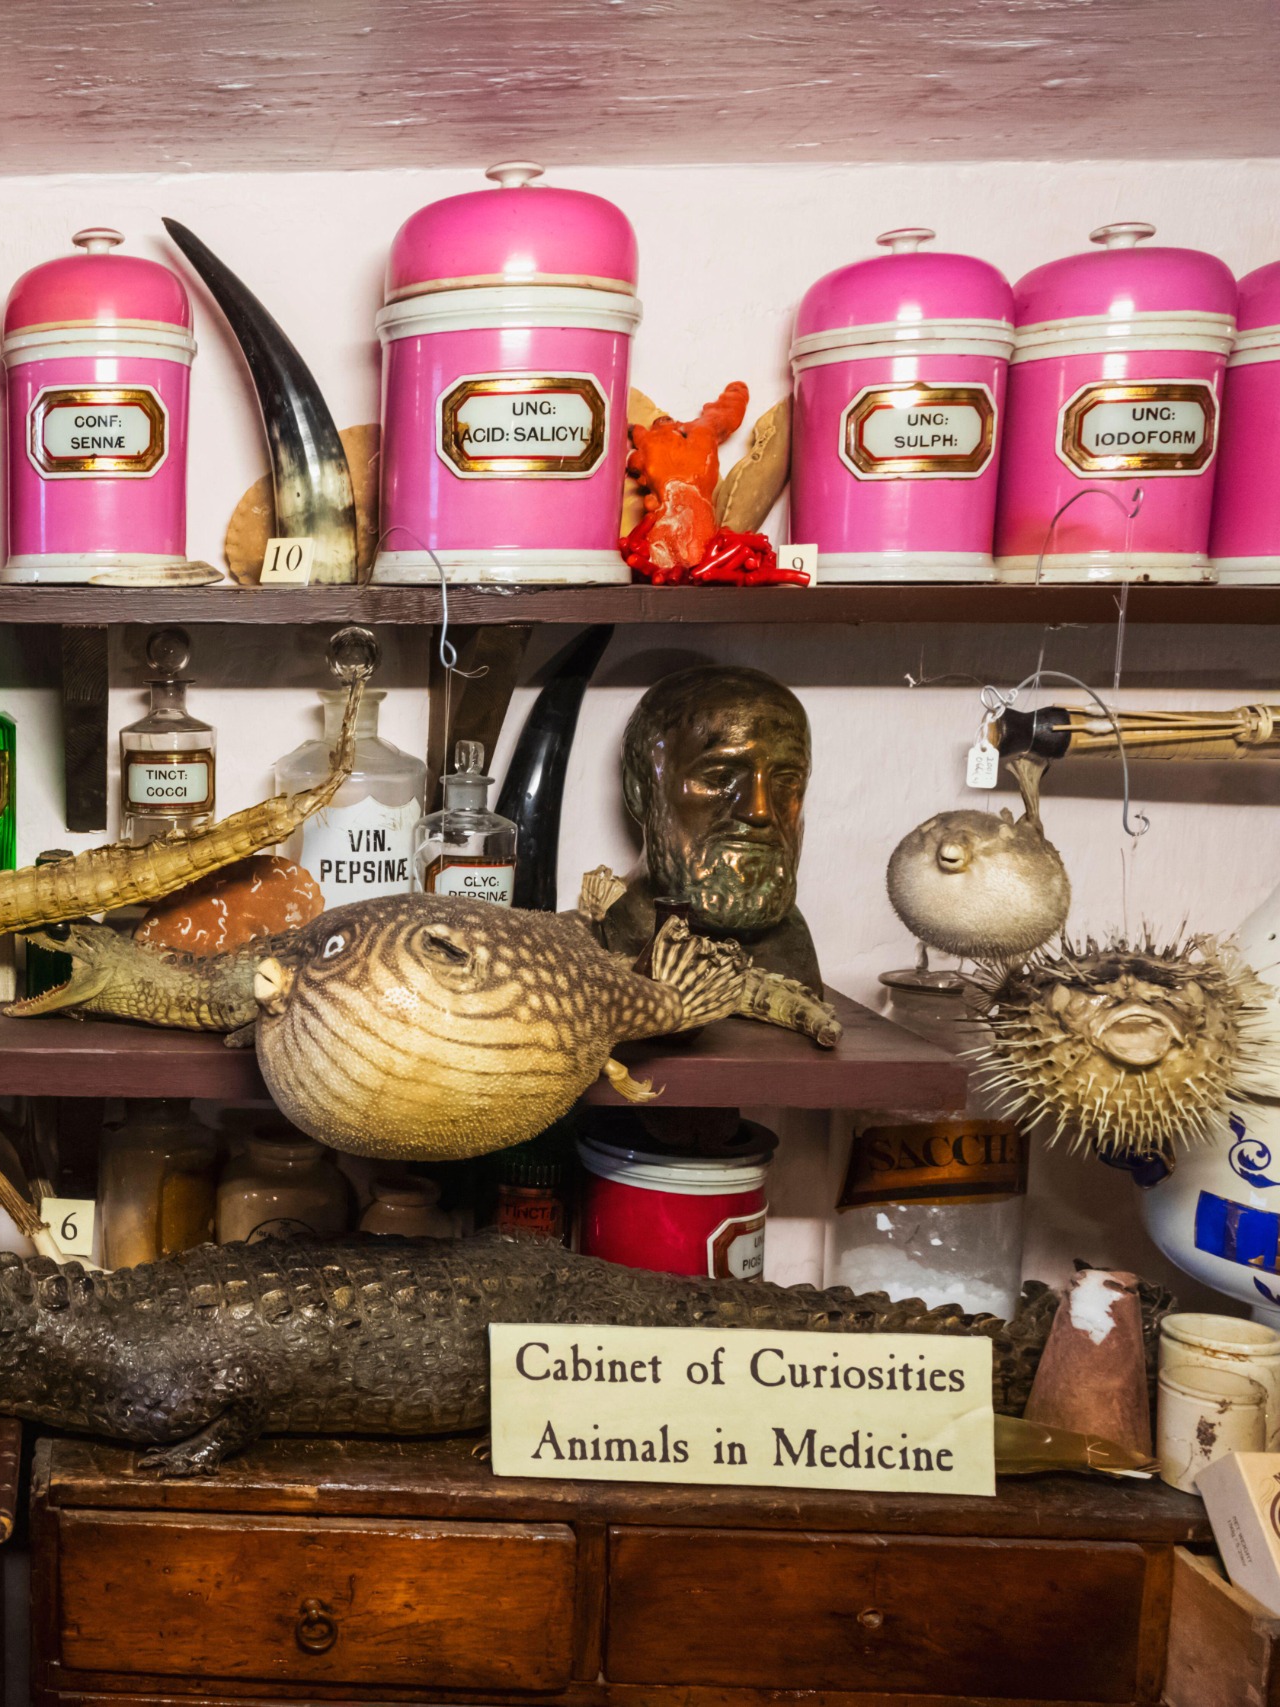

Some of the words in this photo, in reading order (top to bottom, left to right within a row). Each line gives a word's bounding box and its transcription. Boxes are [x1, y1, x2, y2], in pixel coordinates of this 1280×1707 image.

[511, 401, 557, 416] UNG:
[1131, 407, 1176, 421] UNG:
[74, 415, 122, 428] CONF:
[906, 413, 949, 427] UNG:
[70, 436, 126, 450] SENNÆ
[460, 427, 510, 444] ACID:
[893, 434, 958, 449] SULPH:
[1094, 430, 1196, 447] IODOFORM
[269, 544, 303, 572] 10
[145, 769, 188, 780] TINCT:
[146, 786, 187, 797] COCCI
[348, 829, 392, 853] VIN.
[463, 876, 500, 888] GLYC:
[60, 1211, 78, 1241] 6
[515, 1342, 663, 1384] Cabinet
[685, 1346, 726, 1386] of
[749, 1348, 966, 1393] Curiosities
[530, 1420, 690, 1464] Animals
[712, 1427, 748, 1466] in
[772, 1426, 955, 1473] Medicine
